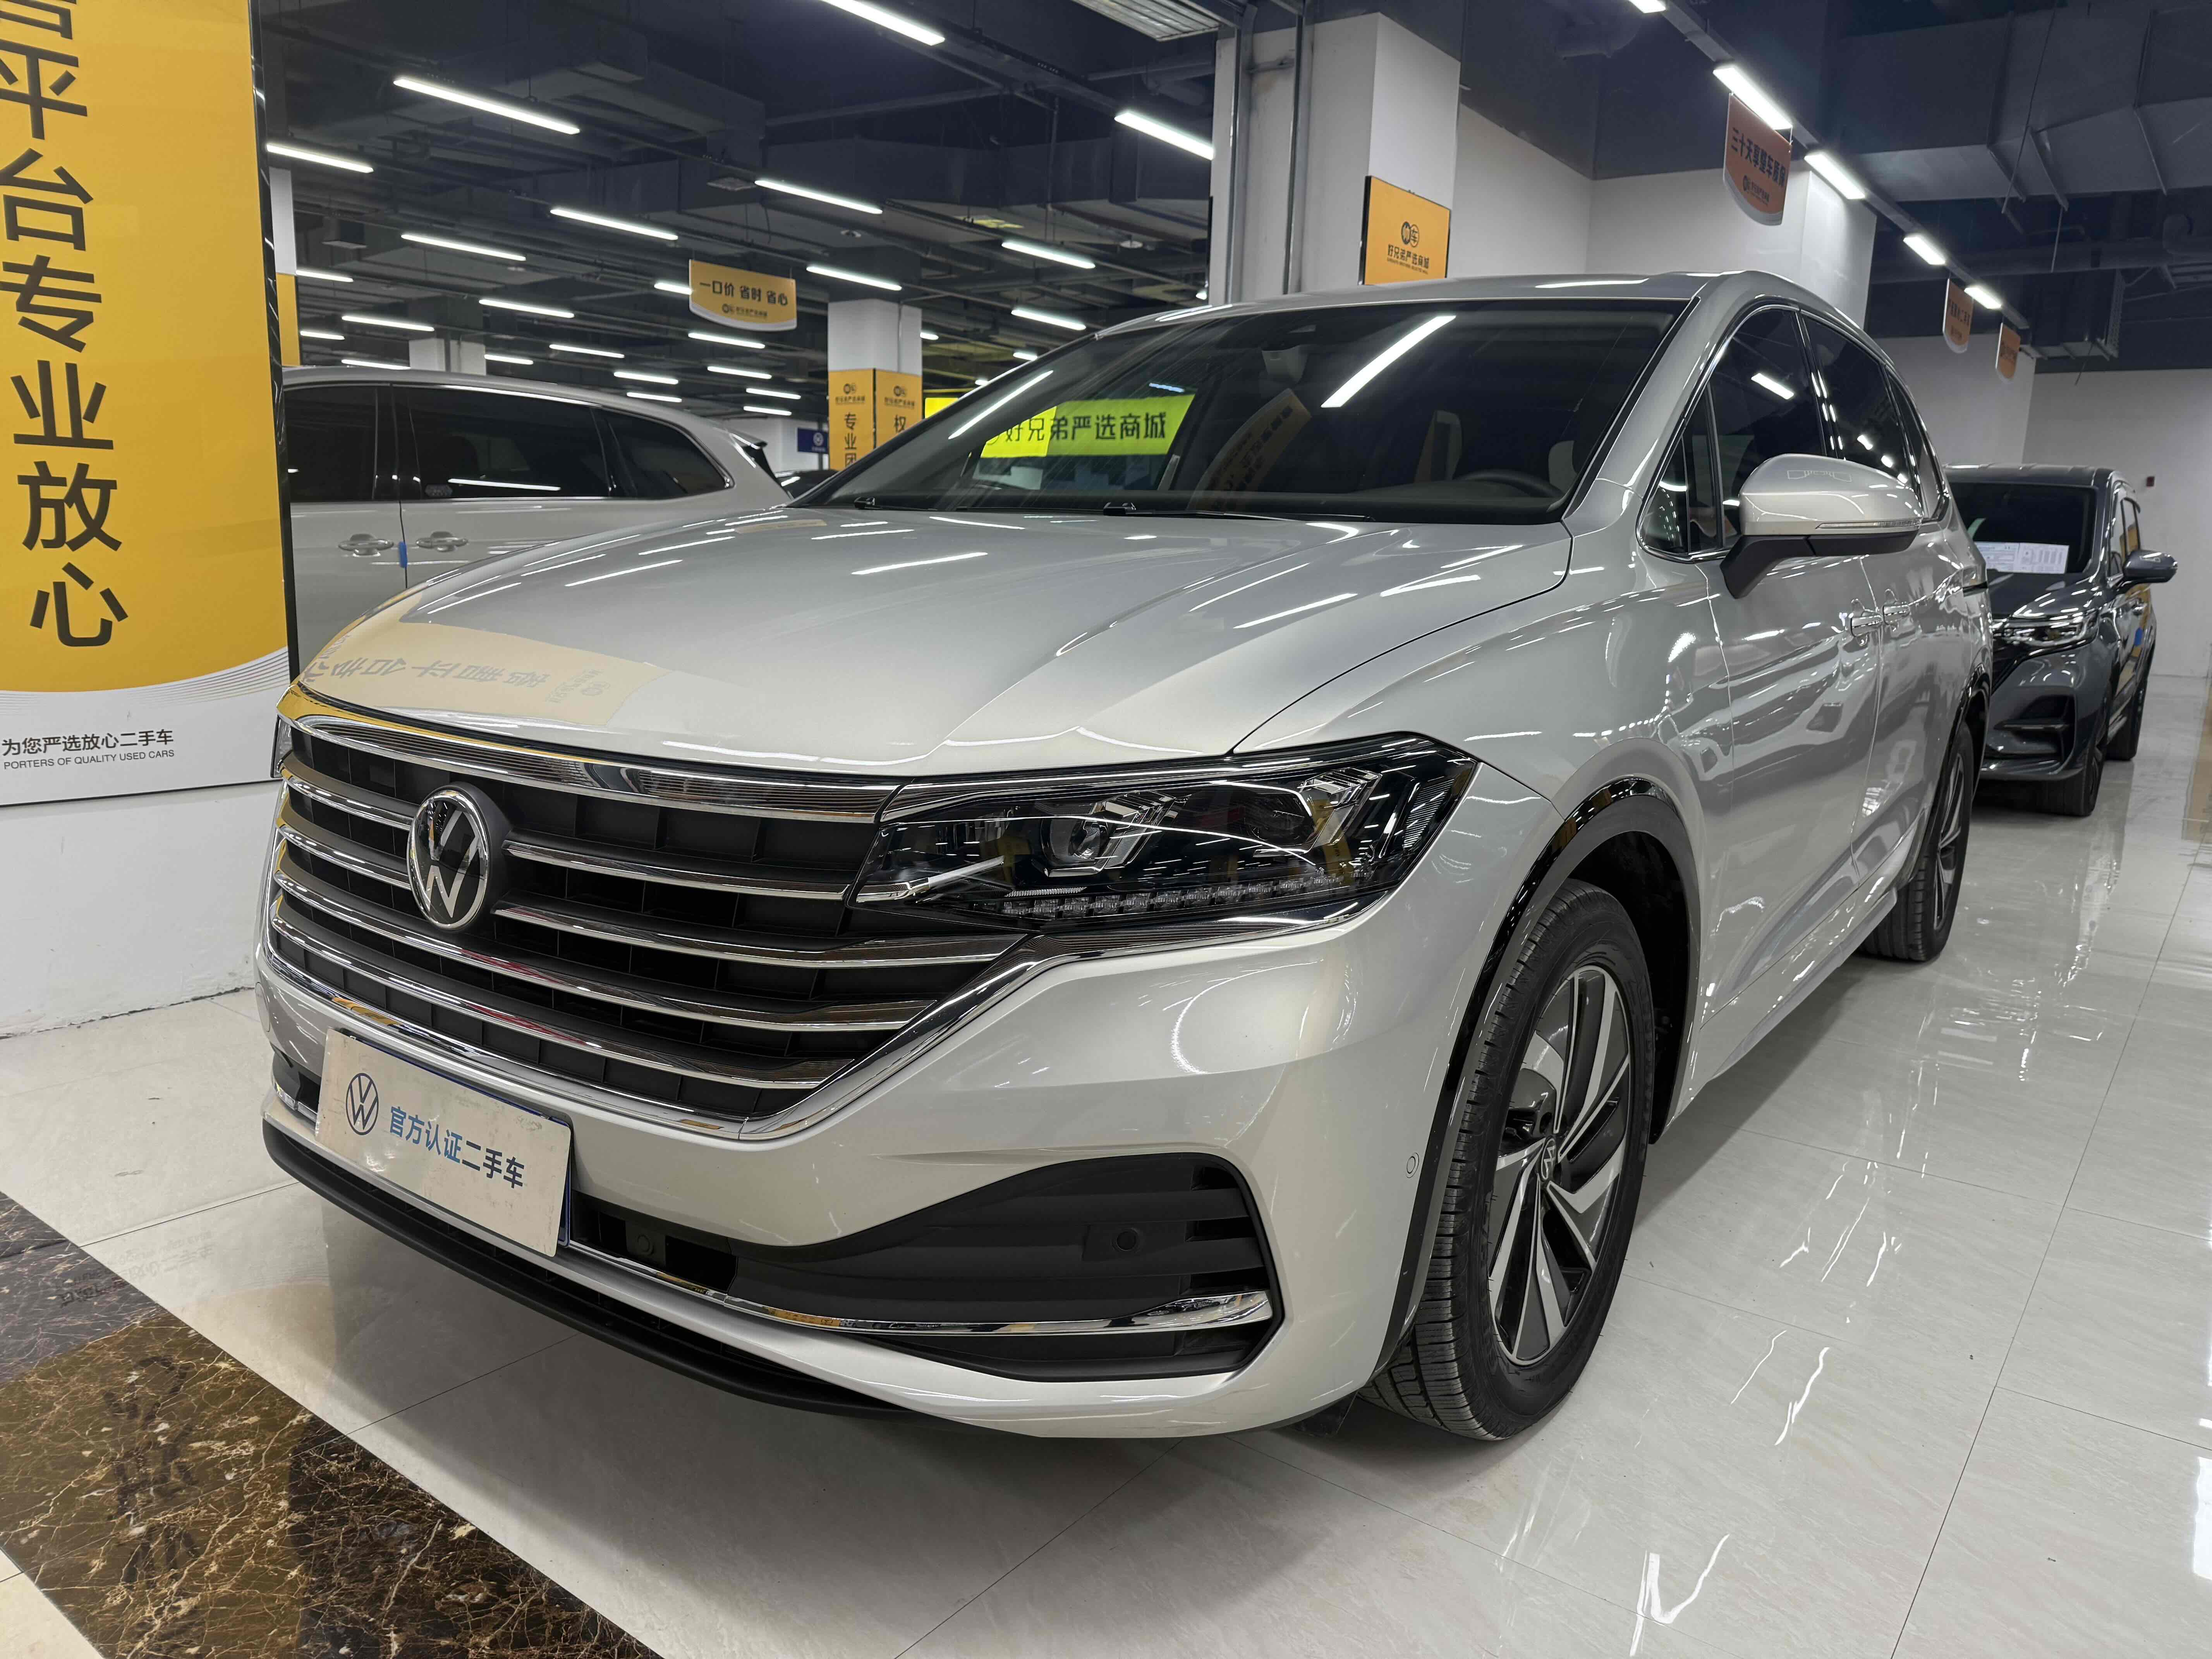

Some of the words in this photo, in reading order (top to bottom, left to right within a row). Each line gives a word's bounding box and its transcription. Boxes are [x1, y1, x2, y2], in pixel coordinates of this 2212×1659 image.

[700, 280, 734, 297] 一口价
[740, 285, 762, 302] 省时
[767, 290, 788, 306] 省心
[2, 729, 174, 756] 为您严选放心二手车
[4, 758, 54, 769] PORTERS
[57, 757, 71, 766] OF
[74, 754, 117, 764] QUALITY
[119, 752, 146, 761] USED
[149, 749, 174, 759] CARS
[389, 1106, 524, 1188] 官方认证二手车
